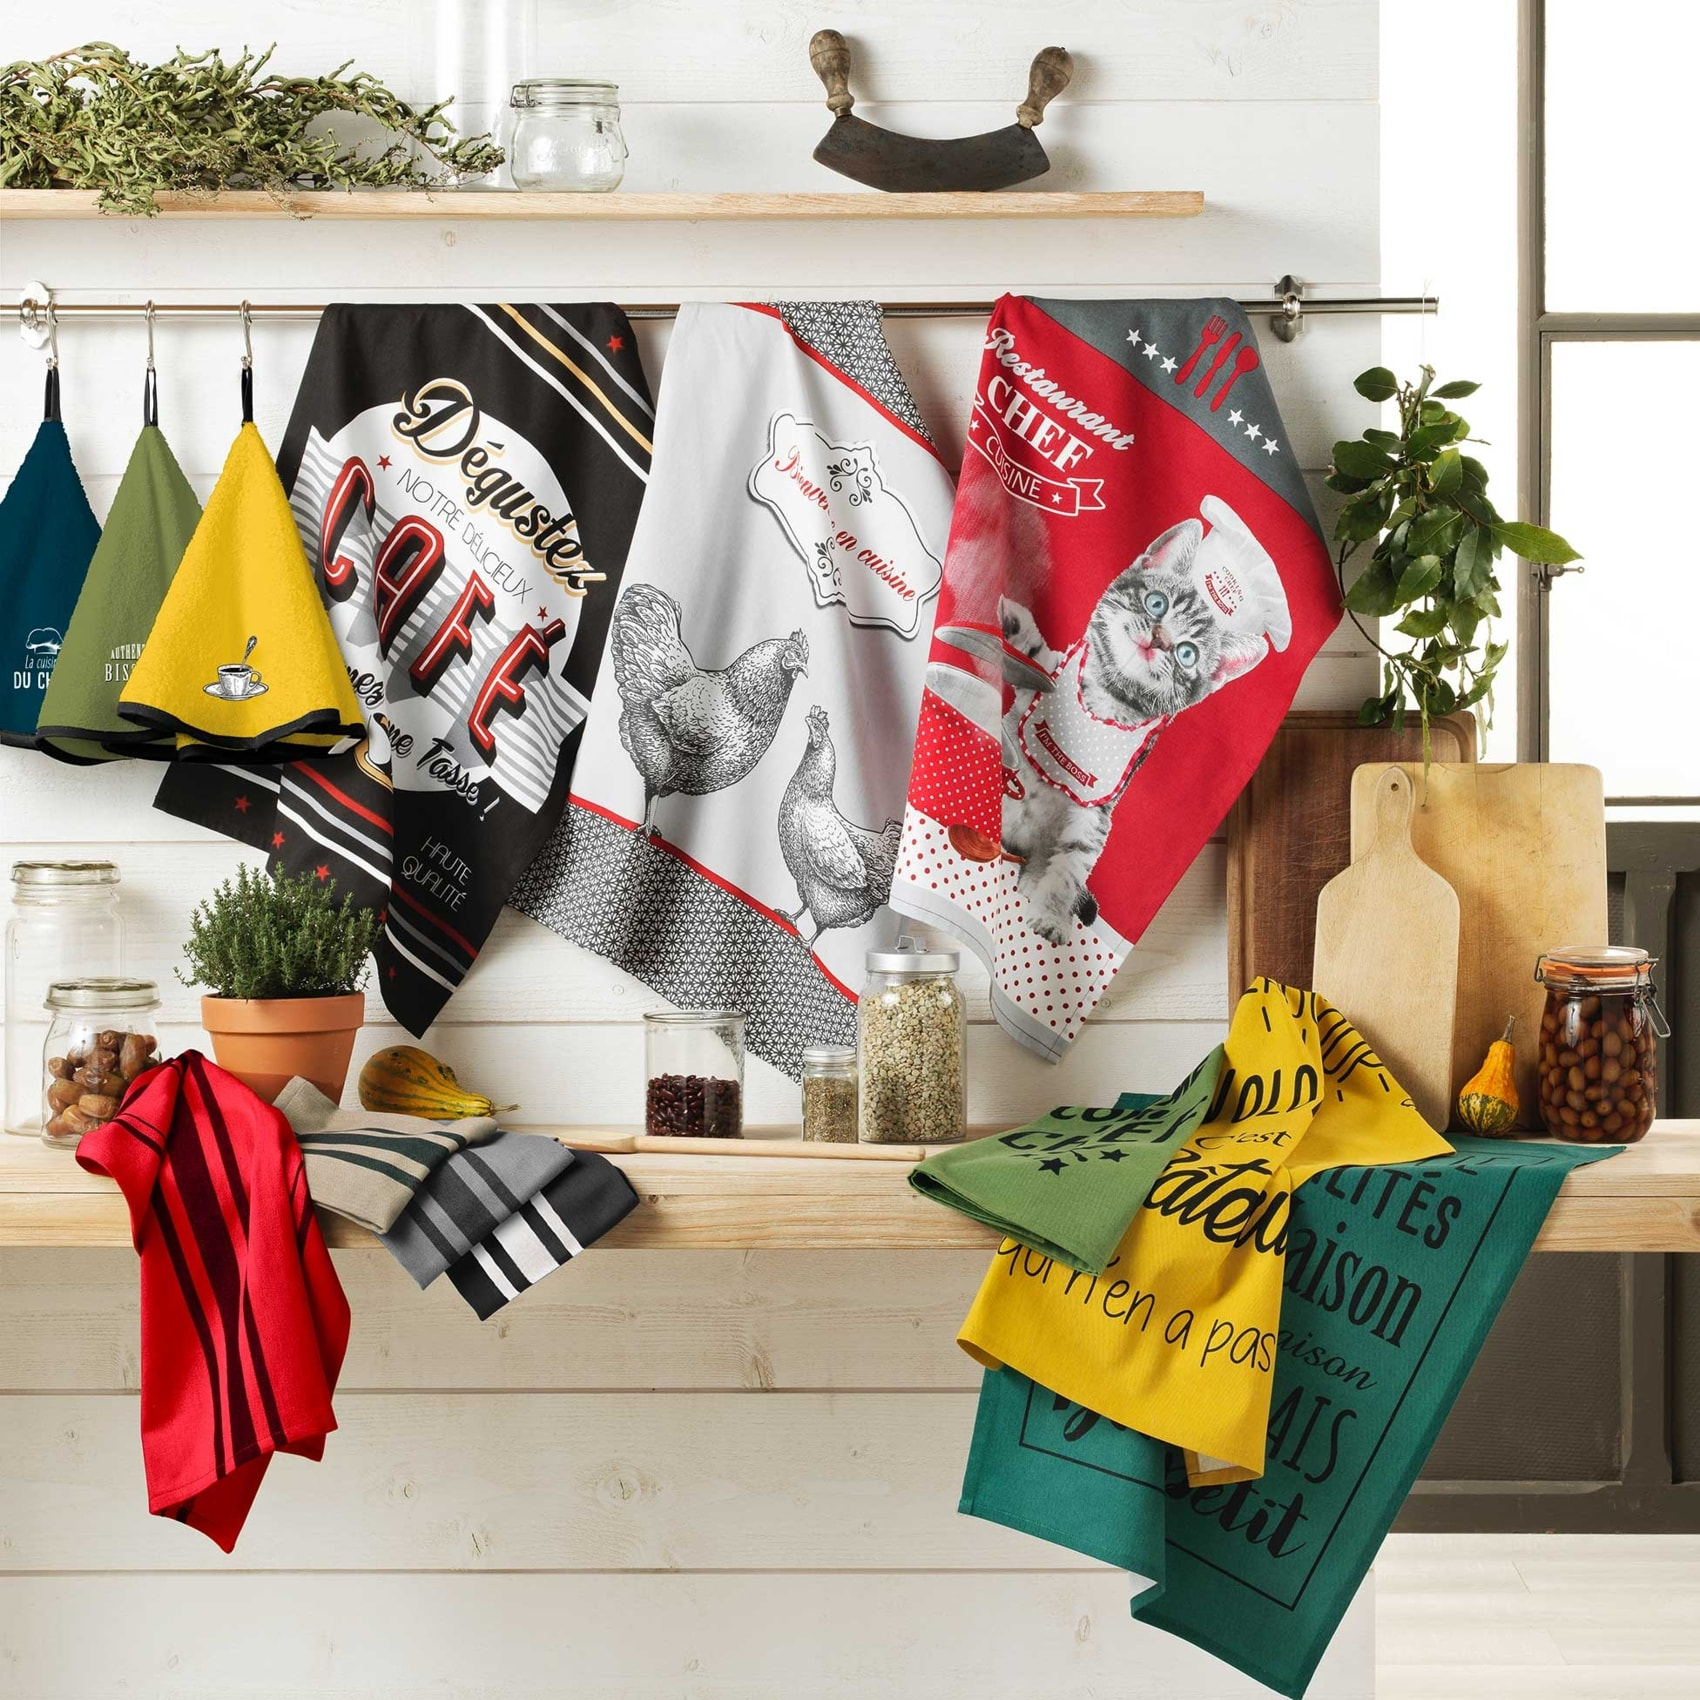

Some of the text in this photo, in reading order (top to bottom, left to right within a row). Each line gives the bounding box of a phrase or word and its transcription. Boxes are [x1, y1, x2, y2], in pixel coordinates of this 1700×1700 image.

[984, 327, 1135, 451] Restaurant
[987, 376, 1094, 473] CHEF
[986, 435, 1042, 499] CUISINE
[397, 468, 534, 605] NOTRE DÉLICIEUX
[835, 531, 858, 551] en
[857, 549, 916, 601] cuisine
[321, 455, 566, 768] CAFÉ
[13, 671, 31, 690] DU
[25, 654, 34, 669] La
[110, 643, 146, 660] AUTHEN
[416, 737, 480, 806] Tasse
[1050, 747, 1067, 765] THE
[1065, 762, 1087, 782] BOSS
[401, 835, 473, 912] HAUTE QUALITÉ
[1311, 1167, 1462, 1250] LITÉS
[1284, 1193, 1423, 1349] aison
[1164, 1309, 1195, 1350] a
[1200, 1319, 1276, 1373] pas
[1278, 1330, 1378, 1391] aison
[1267, 1385, 1358, 1483] AIS
